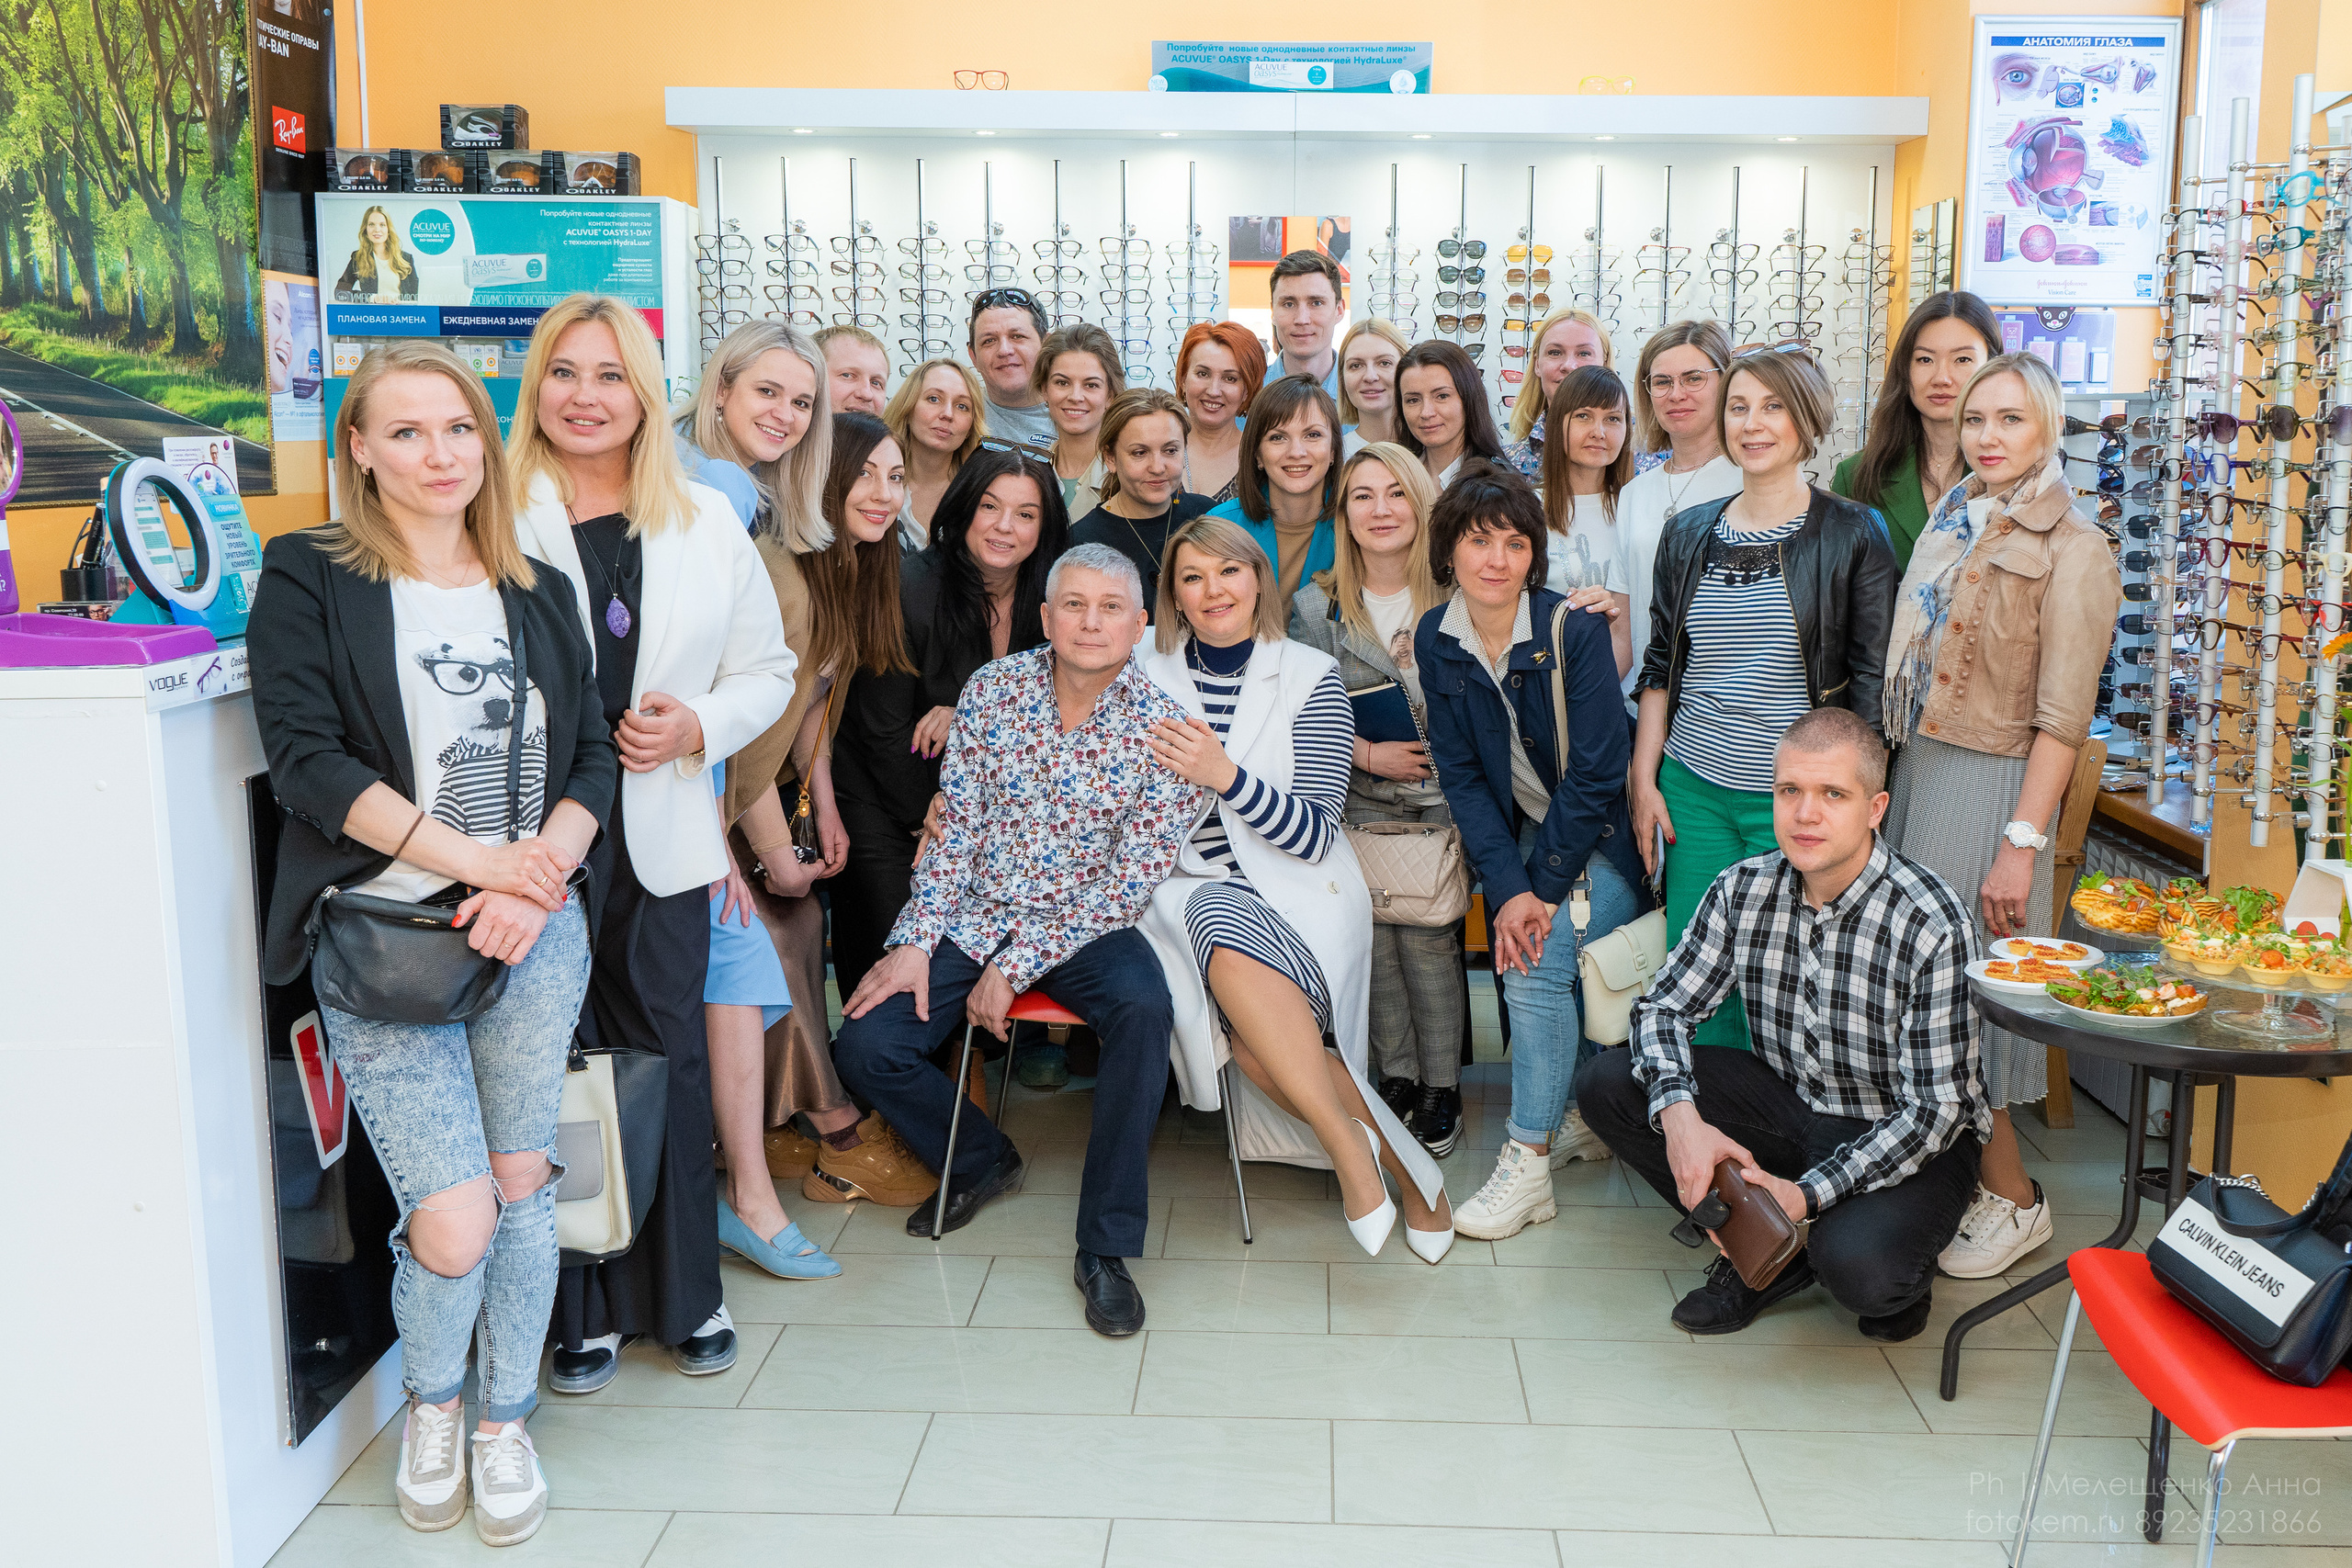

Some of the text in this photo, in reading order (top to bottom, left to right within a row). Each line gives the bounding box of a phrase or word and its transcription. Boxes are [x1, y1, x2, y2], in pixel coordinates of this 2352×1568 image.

[290, 32, 320, 51] ОПРАВЫ
[2022, 37, 2133, 47] АНАТОМИЯ ГЛАЗА
[1166, 42, 1225, 53] Попробуйте
[1261, 45, 1326, 54] однодневные
[1218, 55, 1252, 64] OASYS
[1292, 56, 1351, 64] технологией
[539, 209, 582, 219] Попробуйте
[412, 222, 450, 231] ACUVUE
[629, 229, 652, 237] 1-DAY
[471, 258, 507, 268] ACUVUE
[471, 266, 496, 276] oasys
[337, 314, 427, 323] ПЛАНОВАЯ ЗАМЕНА
[443, 316, 540, 326] ЕЖЕДНЕВНАЯ ЗАМЕН
[214, 503, 240, 513] НОВИНКА
[220, 522, 243, 532] ОЩУТИТЕ
[225, 531, 243, 540] НОВЫЙ
[226, 541, 248, 549] УРОВЕНЬ
[224, 549, 256, 559] ЗРИТЕЛЬНОГО
[231, 558, 256, 569] КОМФОРТА
[230, 654, 250, 668] Созда
[2177, 1218, 2285, 1298] CALVIN KLEIN JEANS
